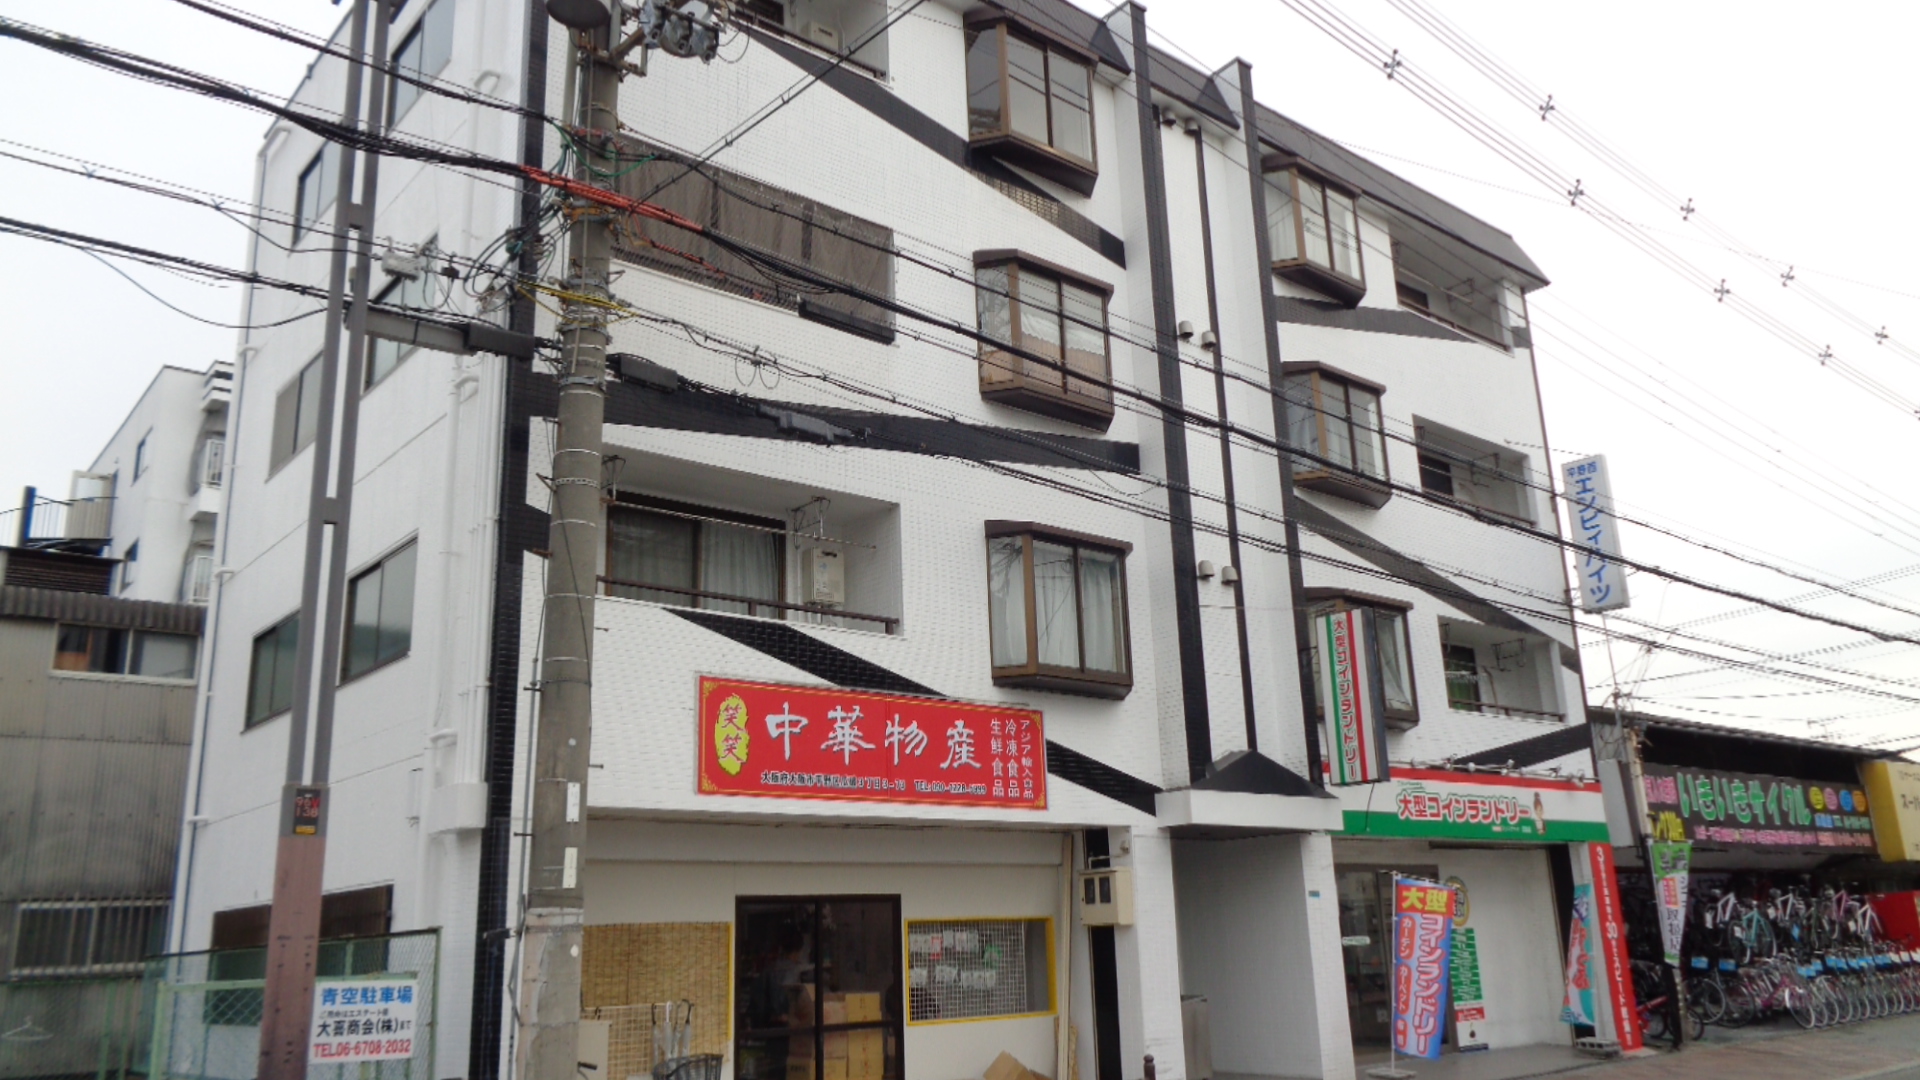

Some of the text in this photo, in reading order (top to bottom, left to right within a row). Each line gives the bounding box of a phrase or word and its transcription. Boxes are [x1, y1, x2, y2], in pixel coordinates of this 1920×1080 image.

[1334, 618, 1358, 780] 大型コインランドリー
[719, 703, 747, 764] 笑笑
[765, 701, 981, 770] 中華物産
[990, 717, 1005, 798] 生鮮食品
[1005, 718, 1020, 798] 冷凍食品
[1398, 793, 1531, 824] 大型コインランドリー
[1676, 772, 1812, 826] いきいきサイクル
[1402, 886, 1448, 913] 大型
[1400, 917, 1412, 958] カーテン
[322, 985, 414, 1007] 青空駐車場
[1414, 914, 1445, 1055] コインランドリー
